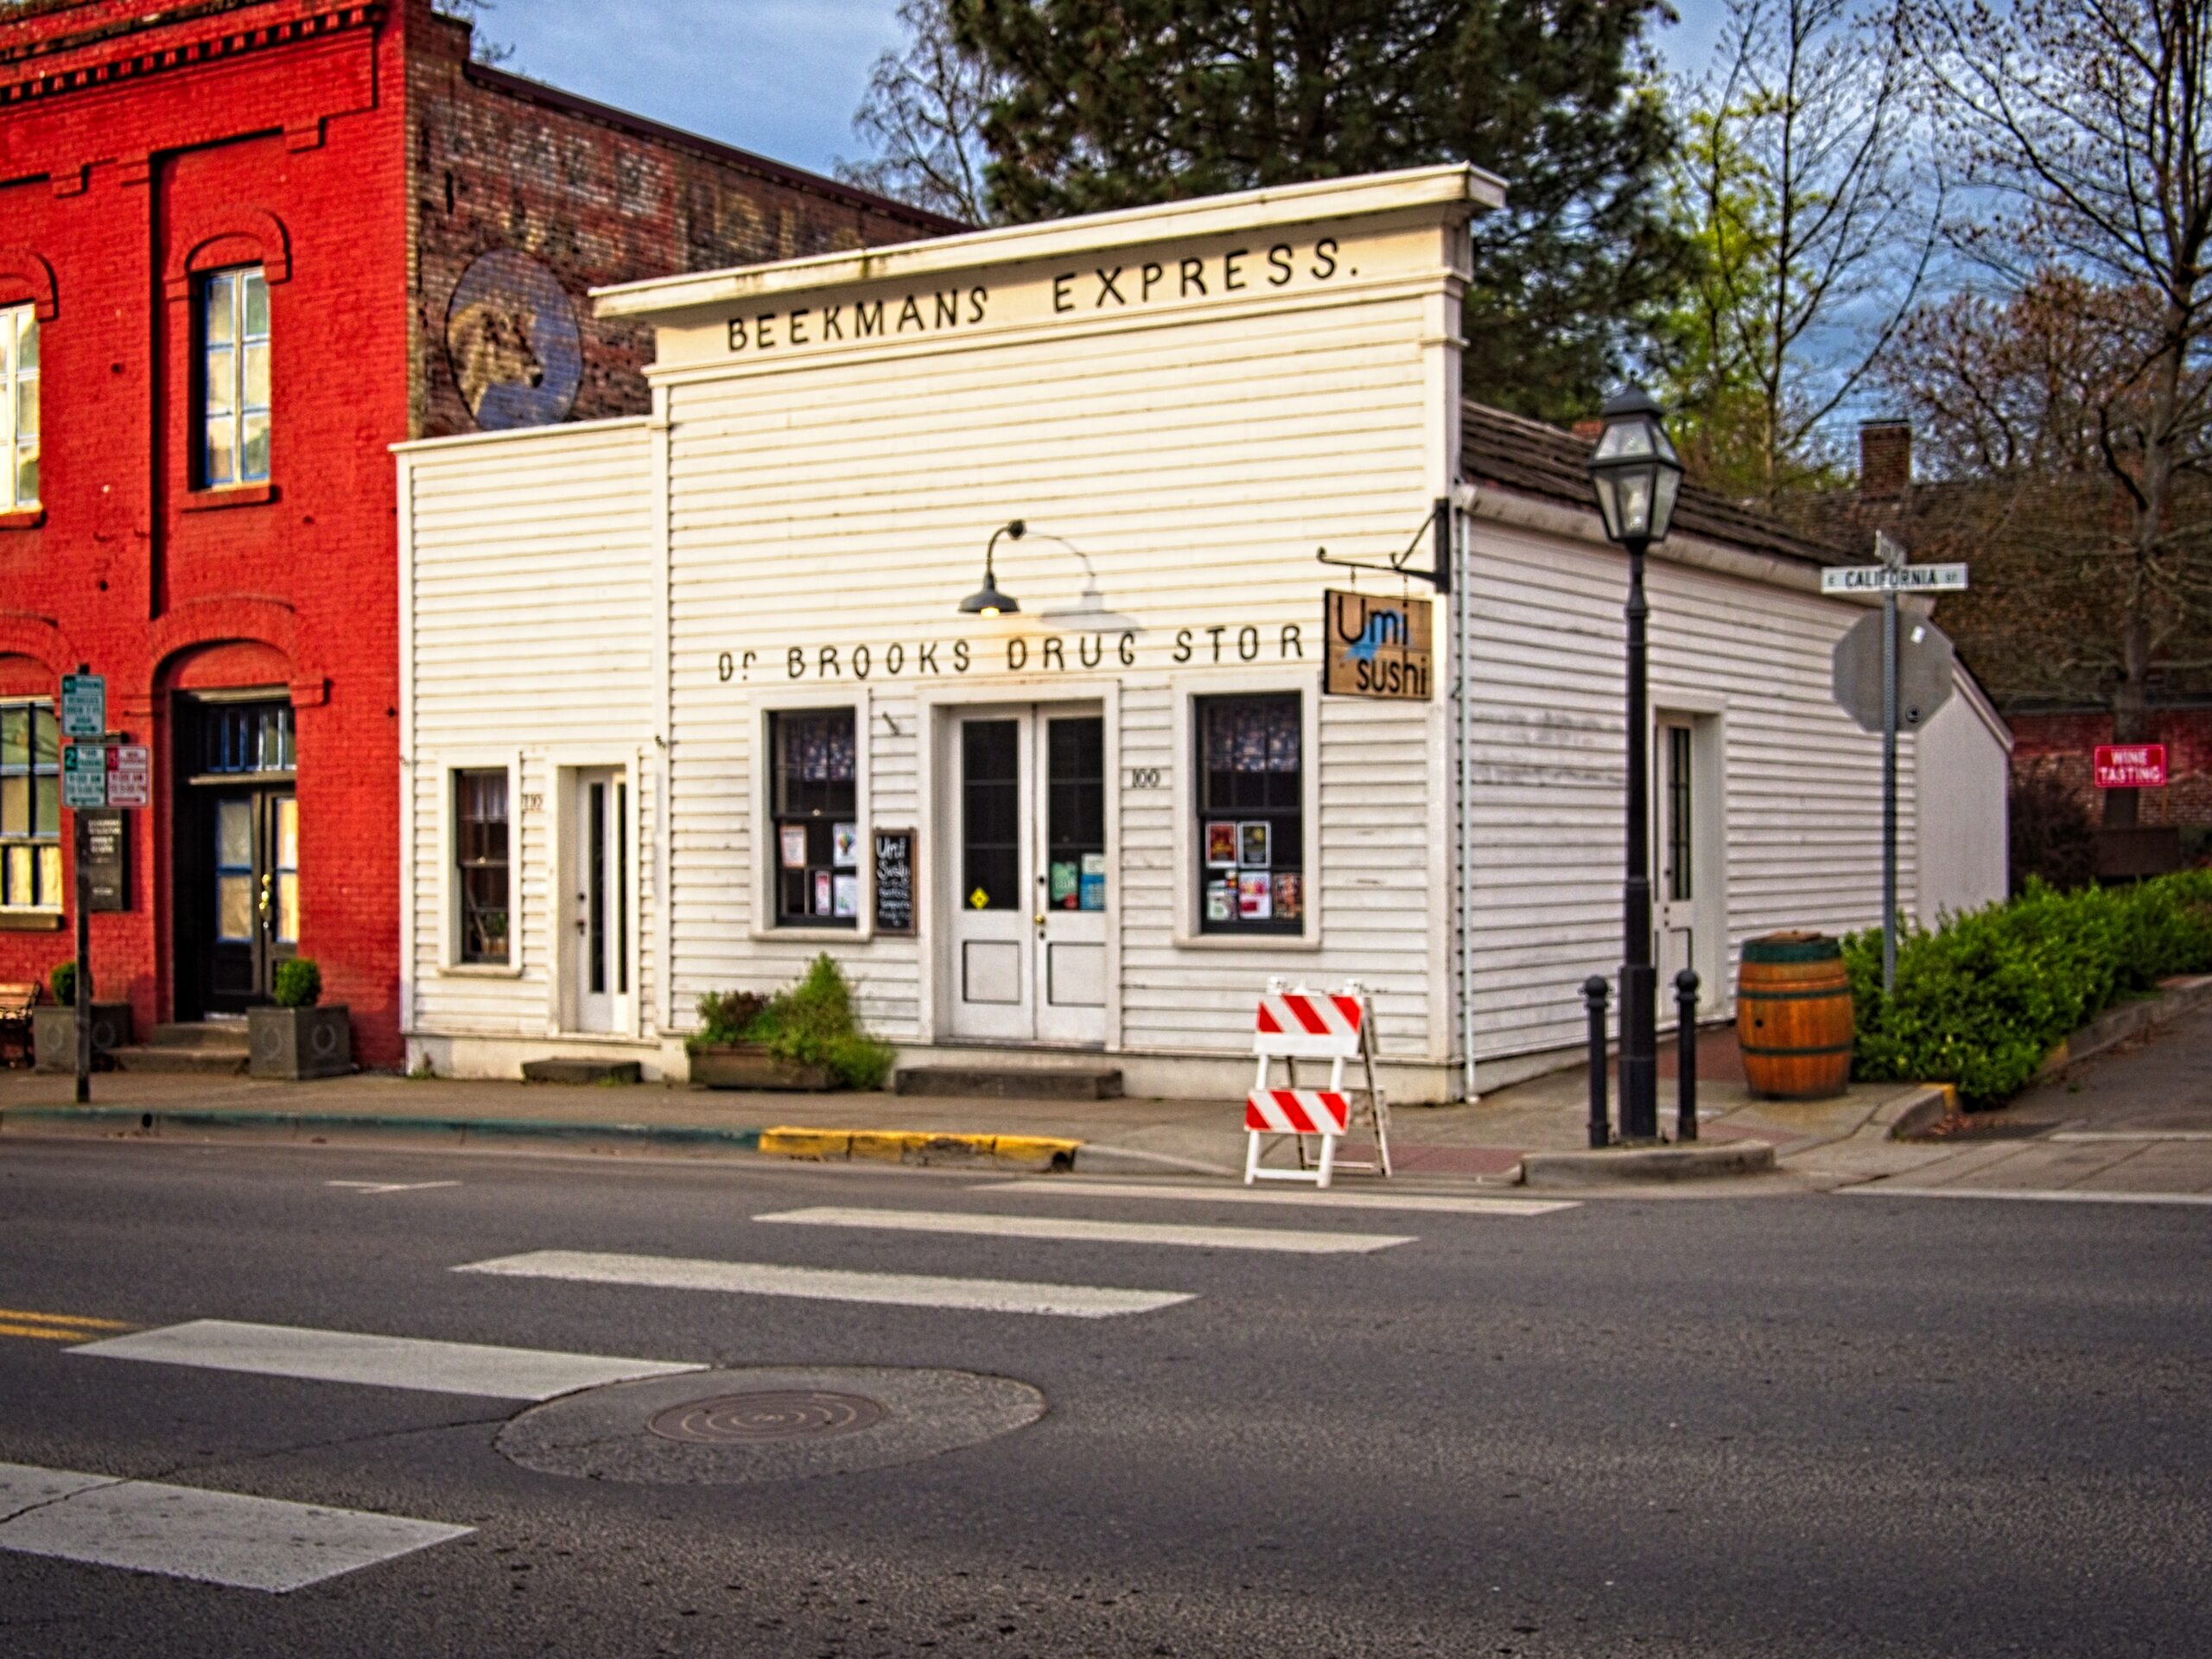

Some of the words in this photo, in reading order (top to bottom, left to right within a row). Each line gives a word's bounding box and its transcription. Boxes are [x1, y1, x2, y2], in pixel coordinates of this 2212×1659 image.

[728, 285, 988, 353] BEEKMANS
[1052, 237, 1358, 314] EXPRESS.
[1845, 569, 1938, 589] CALIFORNIA
[1337, 594, 1408, 646] Umi
[787, 639, 971, 681] BROOKS
[1007, 632, 1136, 671] DRUG
[1173, 623, 1304, 663] STOR
[1356, 649, 1427, 695] sushi
[2111, 748, 2148, 766] WINE
[1132, 767, 1160, 788] 100
[2098, 766, 2160, 784] TASTING
